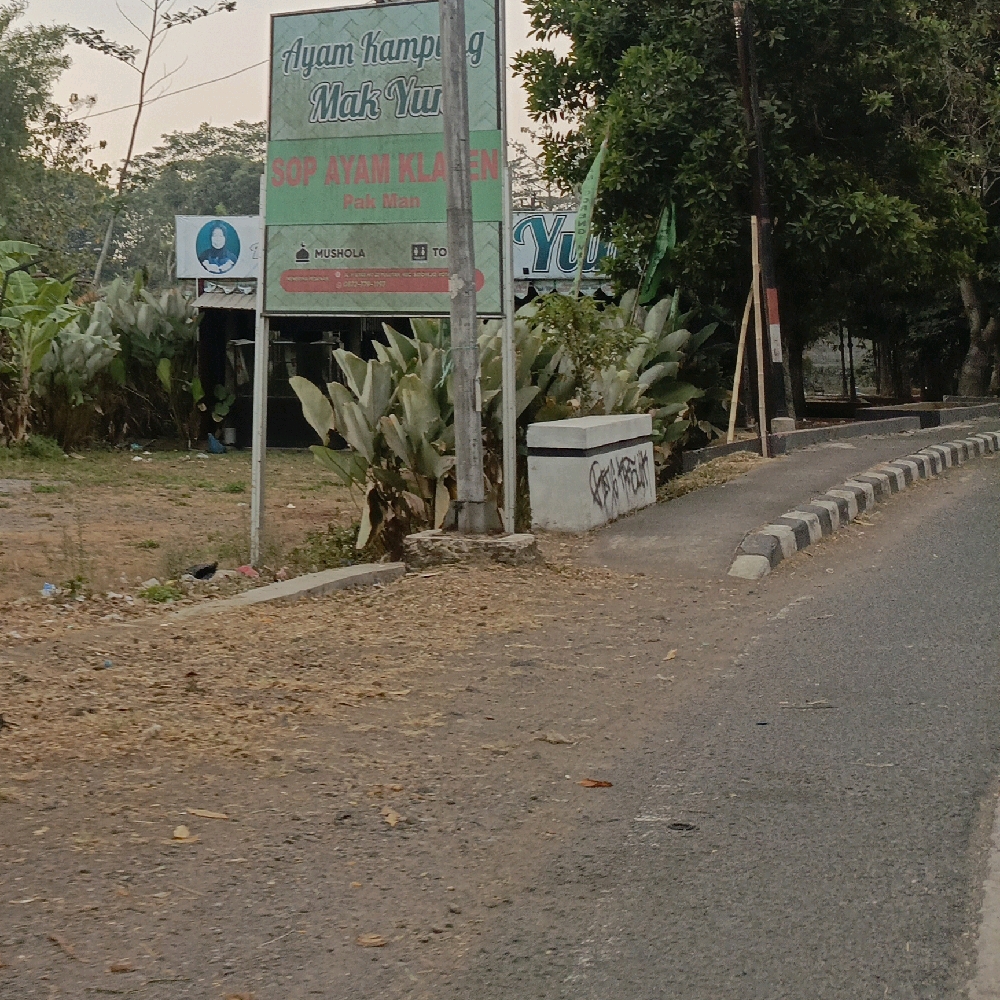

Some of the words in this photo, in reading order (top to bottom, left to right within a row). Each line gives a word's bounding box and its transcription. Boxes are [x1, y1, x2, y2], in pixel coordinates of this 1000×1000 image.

[282, 37, 354, 78] Ayam
[309, 81, 380, 122] Mak
[271, 156, 318, 187] SOP
[325, 153, 390, 185] AYAM
[398, 149, 499, 183] KLAEN
[343, 194, 377, 209] Pak
[383, 193, 421, 209] Man
[315, 248, 366, 259] MUSHOLA
